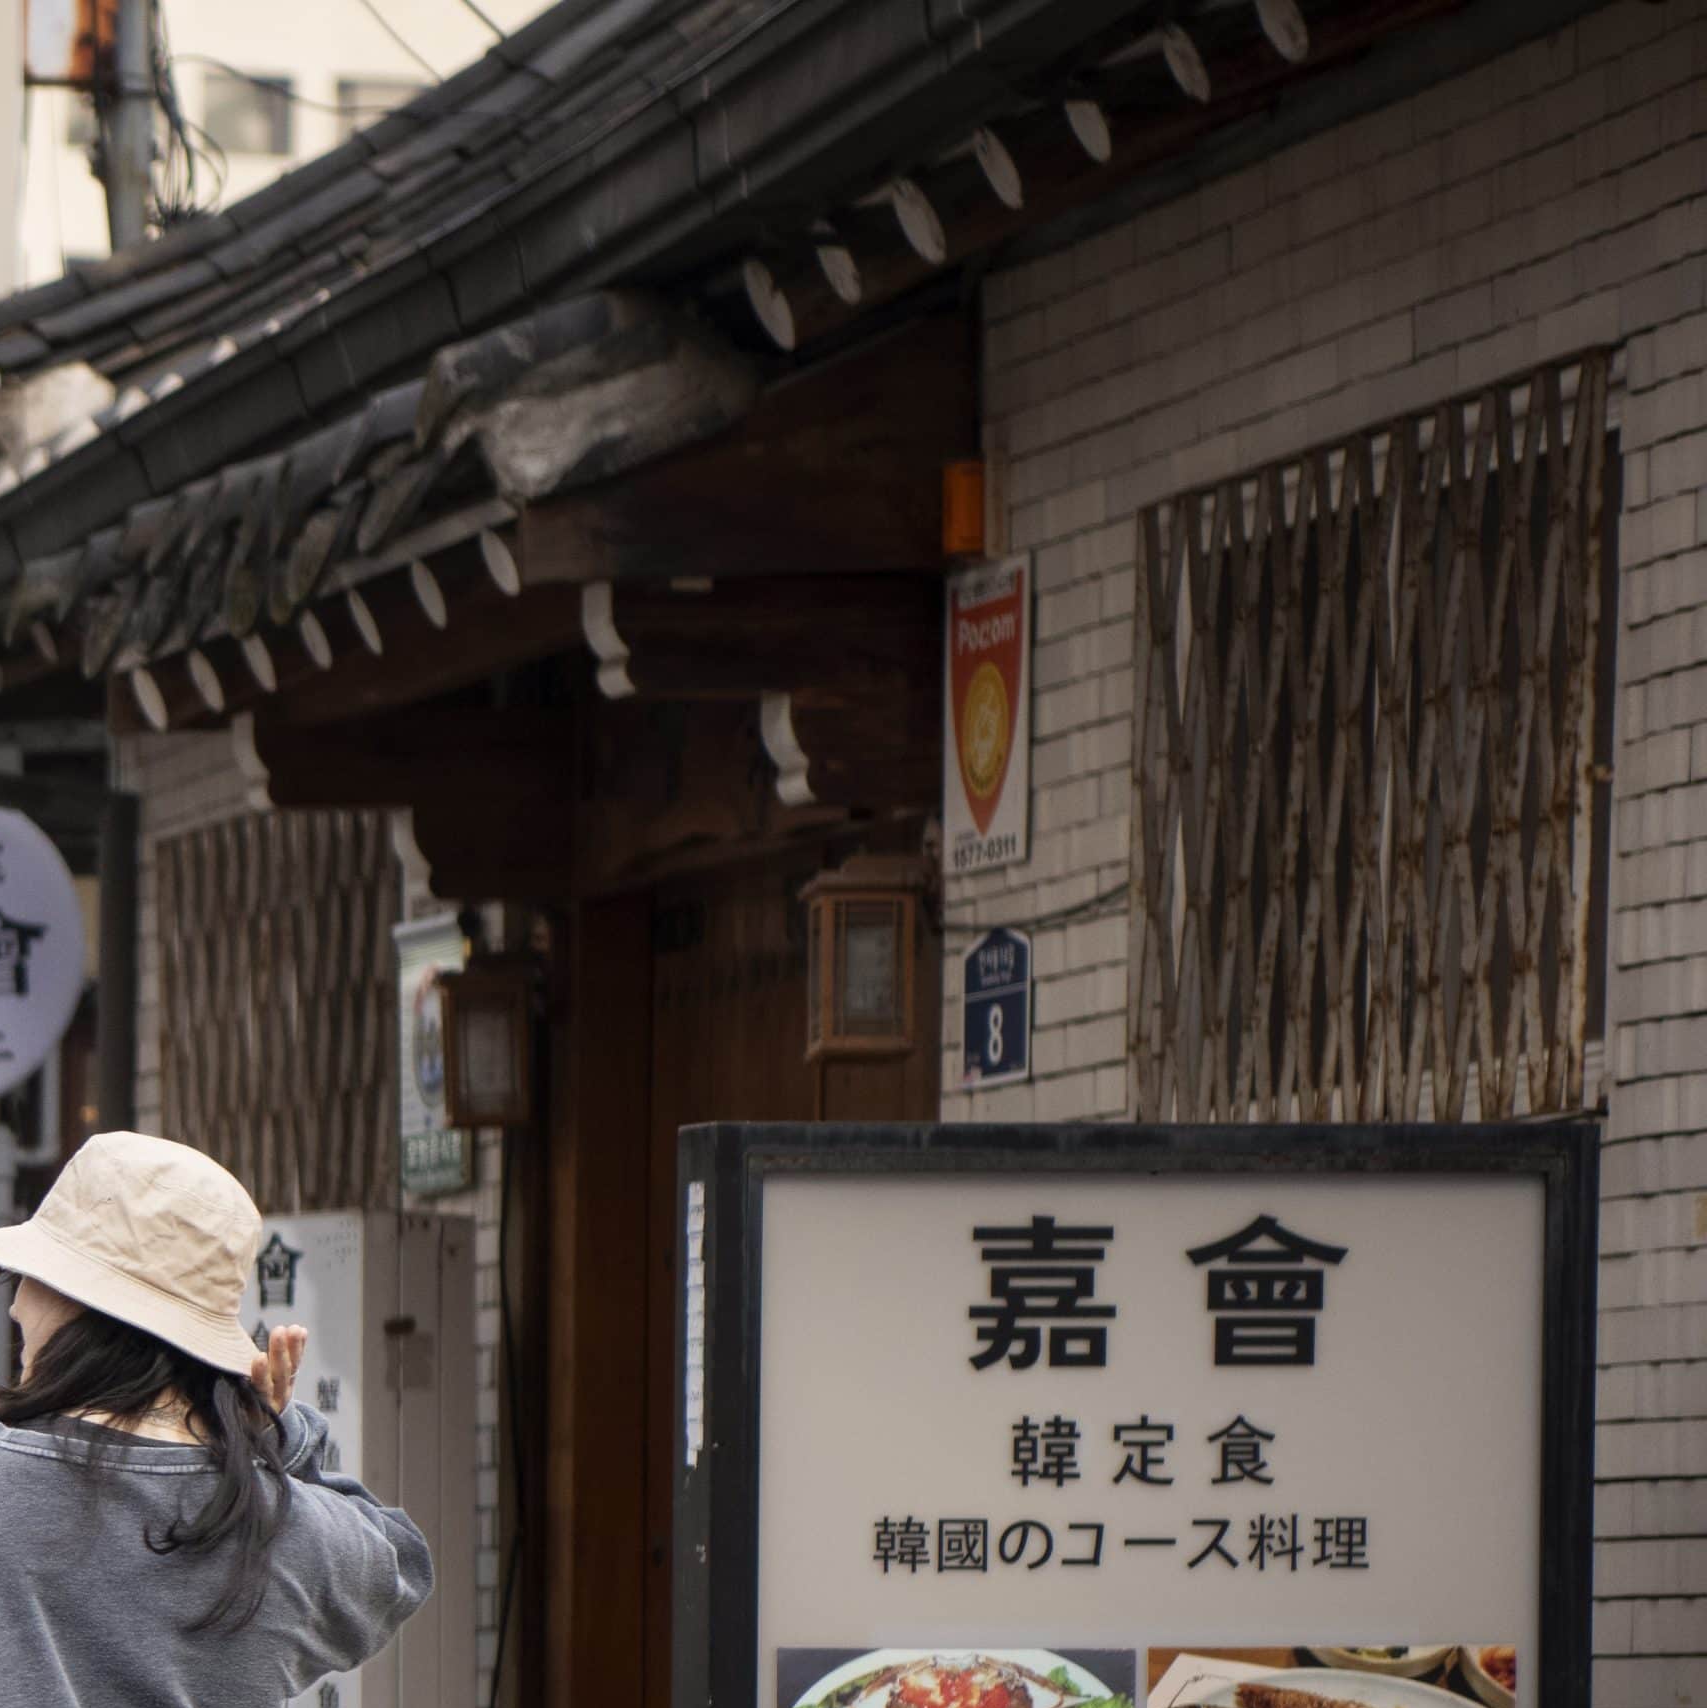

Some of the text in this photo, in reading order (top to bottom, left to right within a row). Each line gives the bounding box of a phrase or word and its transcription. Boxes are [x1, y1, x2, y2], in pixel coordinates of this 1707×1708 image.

[988, 1002, 1004, 1066] 8
[968, 1213, 1350, 1371] 嘉會
[1010, 1414, 1277, 1488] 韓定食
[872, 1513, 1371, 1575] 韓國のコース料理
